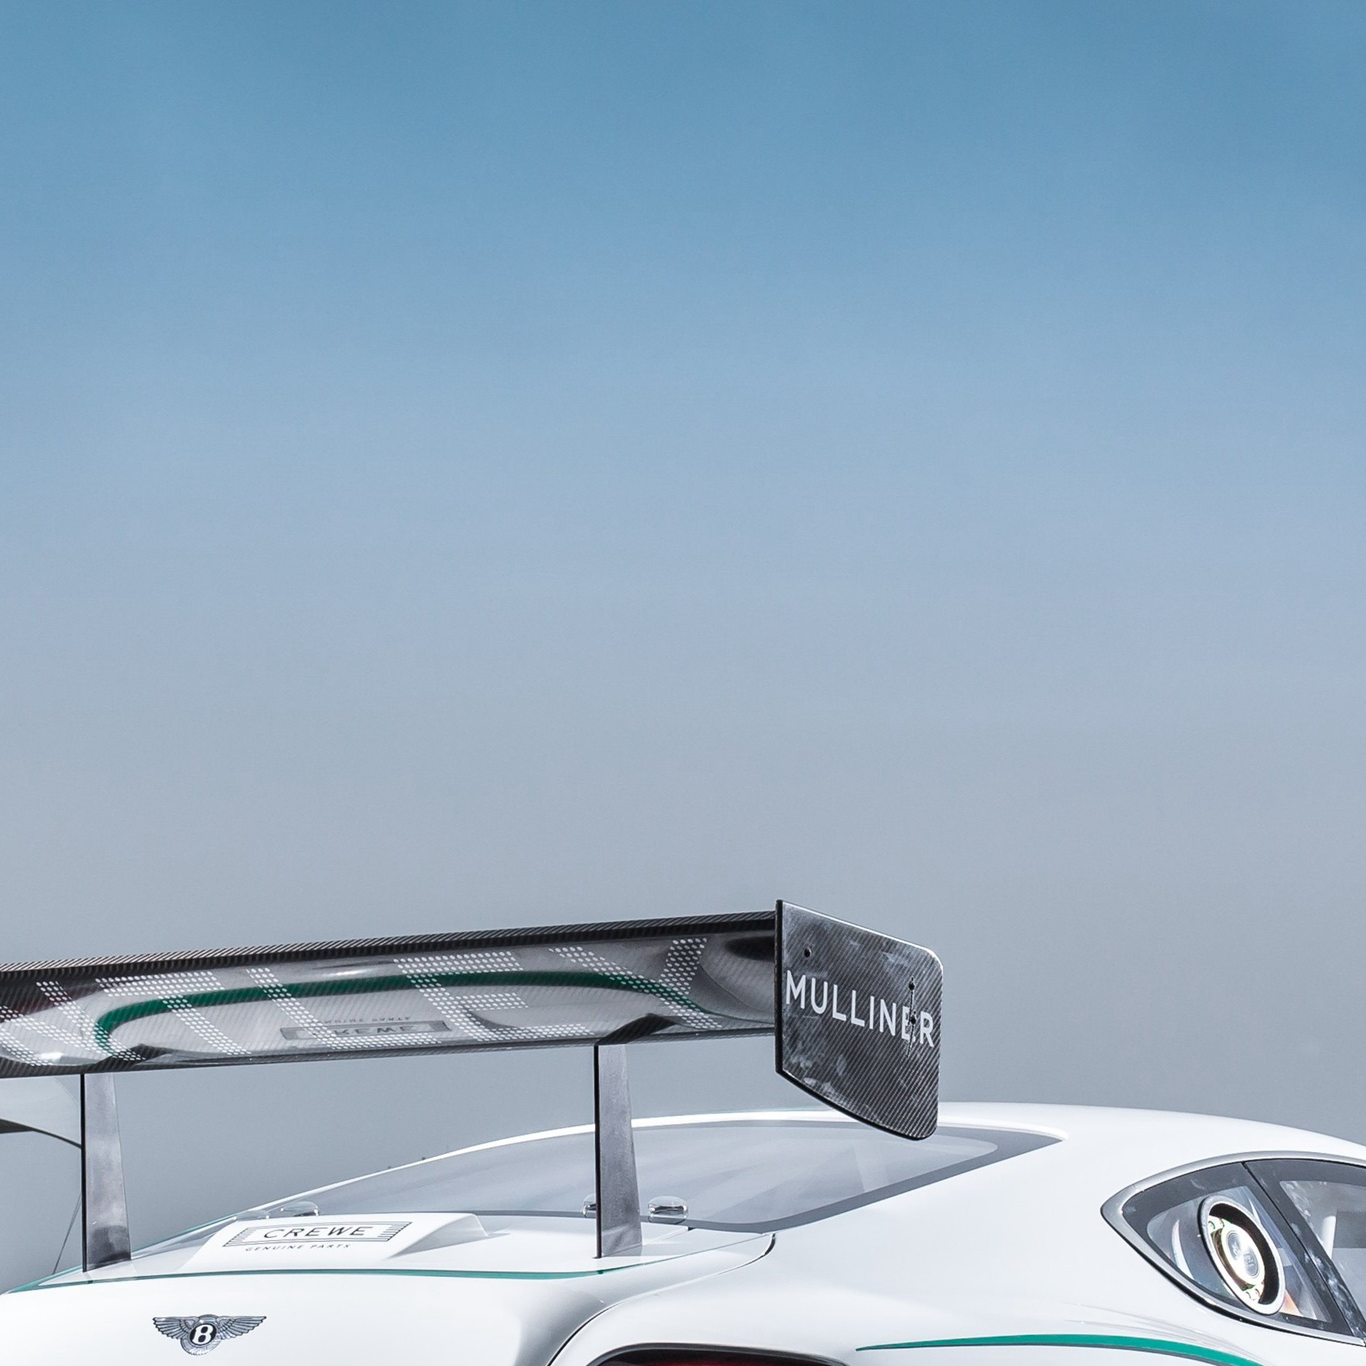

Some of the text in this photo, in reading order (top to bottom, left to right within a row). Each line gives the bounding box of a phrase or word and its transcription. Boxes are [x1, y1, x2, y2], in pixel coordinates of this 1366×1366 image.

[786, 970, 934, 1047] MULLINER
[263, 1226, 374, 1239] CREWE
[245, 1244, 303, 1252] GENUINE
